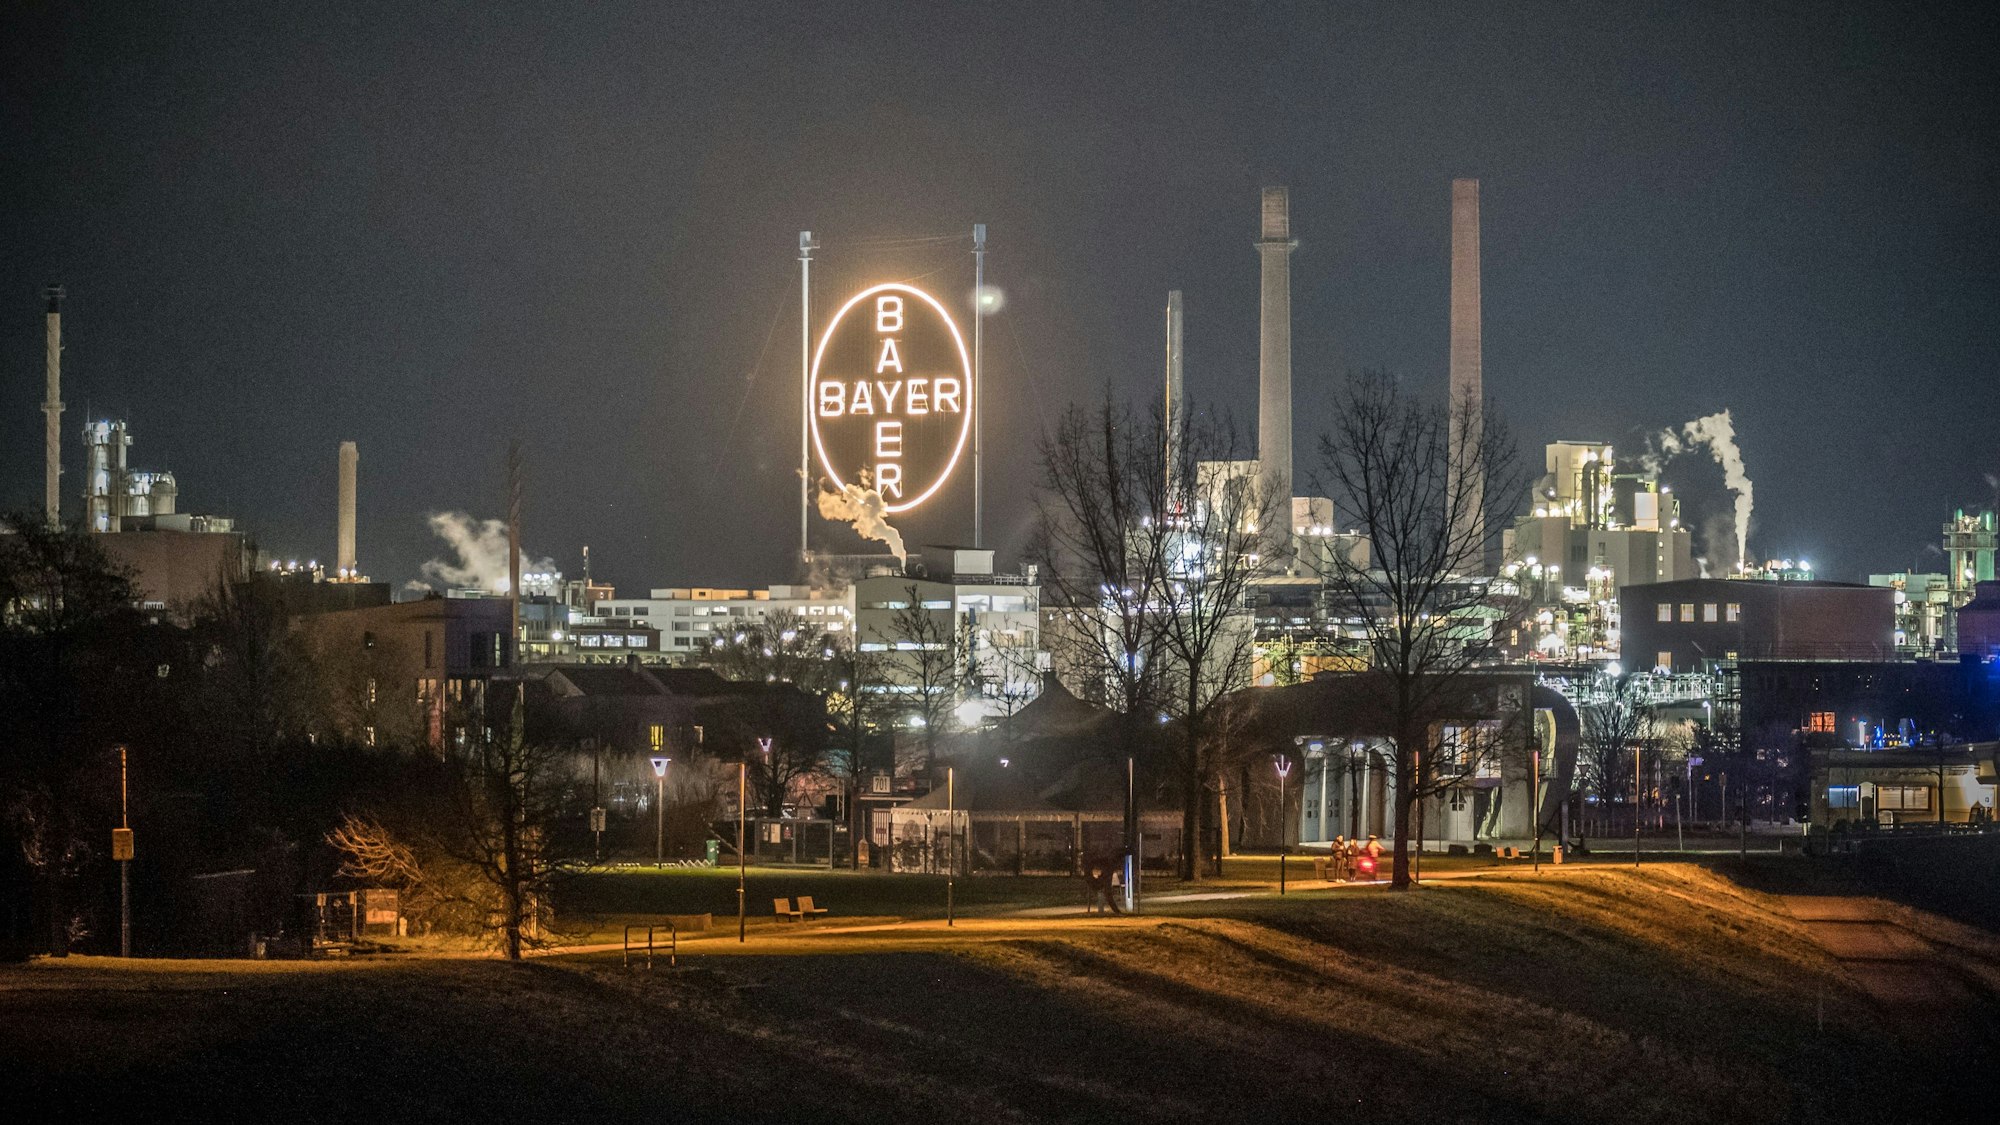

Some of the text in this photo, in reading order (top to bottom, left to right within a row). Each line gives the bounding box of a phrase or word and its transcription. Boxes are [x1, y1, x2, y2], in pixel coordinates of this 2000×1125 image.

[819, 378, 961, 417] BAYER
[876, 296, 903, 499] BAYER
[875, 778, 888, 791] 701
